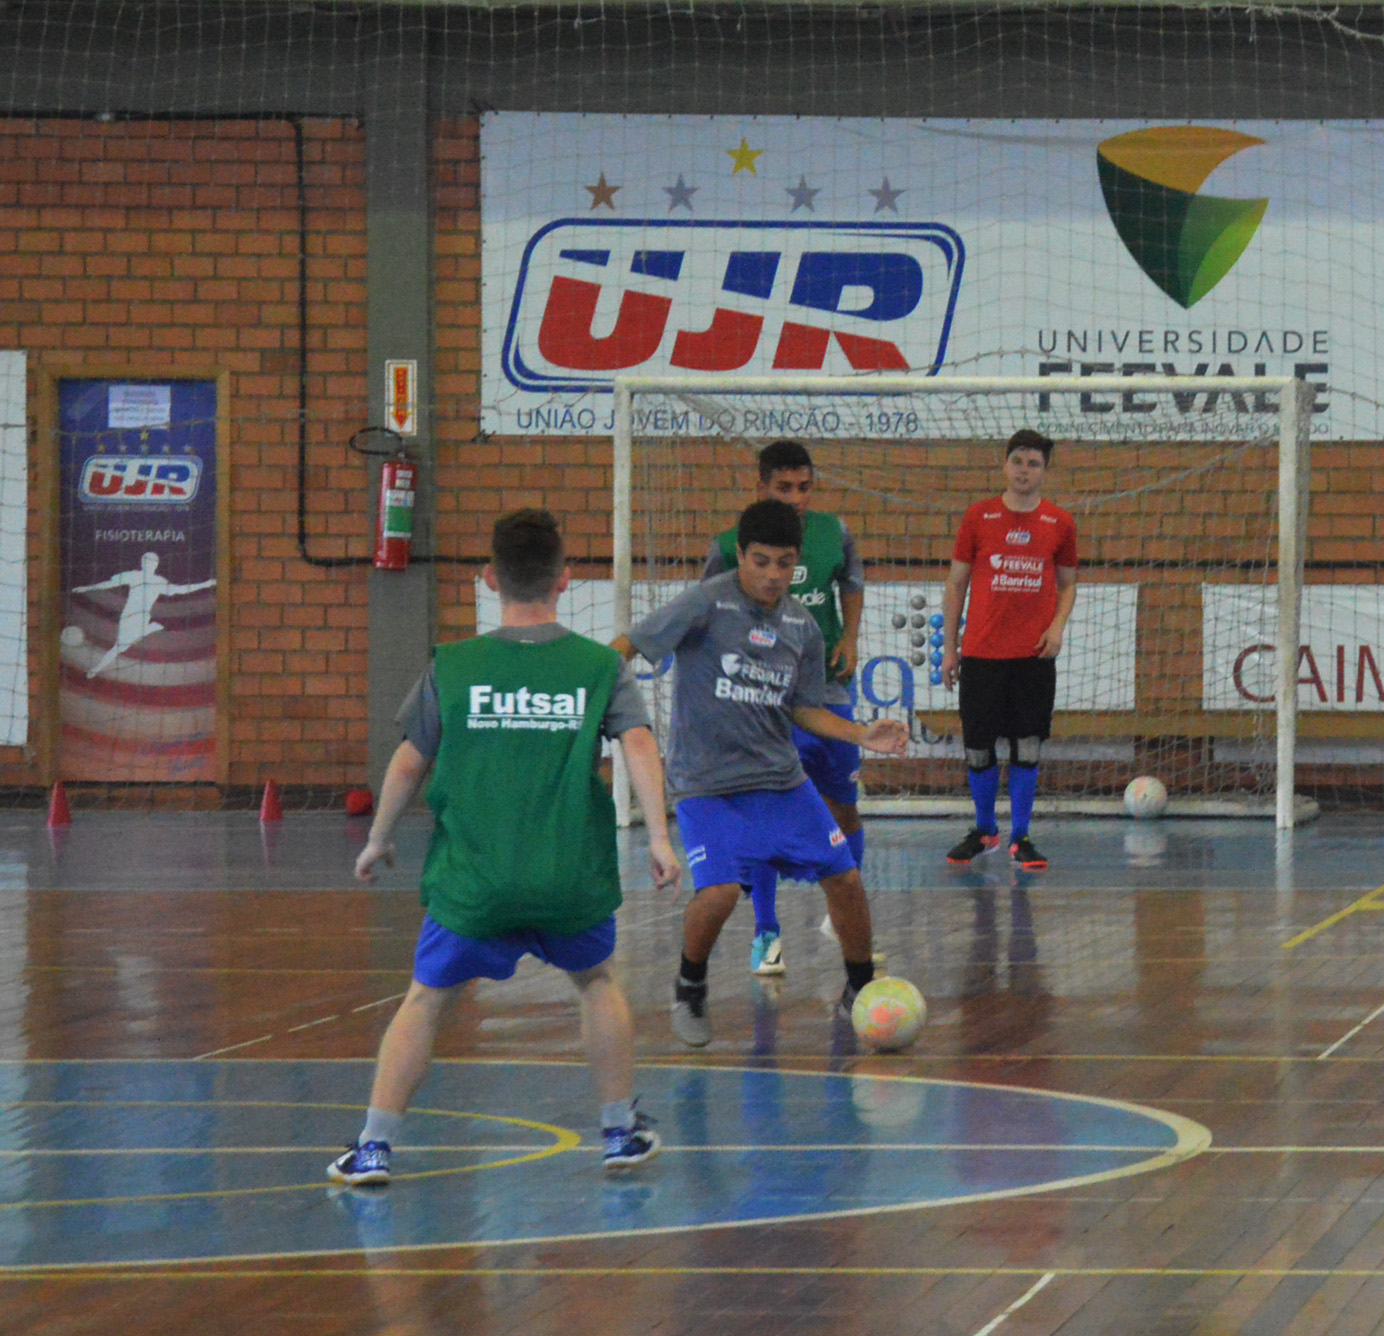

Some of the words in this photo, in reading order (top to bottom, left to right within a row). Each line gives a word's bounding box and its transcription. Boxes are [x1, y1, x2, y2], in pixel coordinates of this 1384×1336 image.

[538, 249, 924, 371] UJR
[1038, 330, 1329, 354] UNIVERSIDADE
[1038, 363, 1330, 414] FEEVALE
[516, 404, 596, 430] UNIÃO
[864, 410, 920, 434] 1978
[88, 463, 190, 495] UJR
[95, 530, 186, 541] FISIOTERAPIA
[1004, 560, 1044, 571] FEEVALE
[1000, 574, 1042, 587] Banrisul
[469, 685, 586, 715] Futsal
[467, 718, 499, 729] Novo
